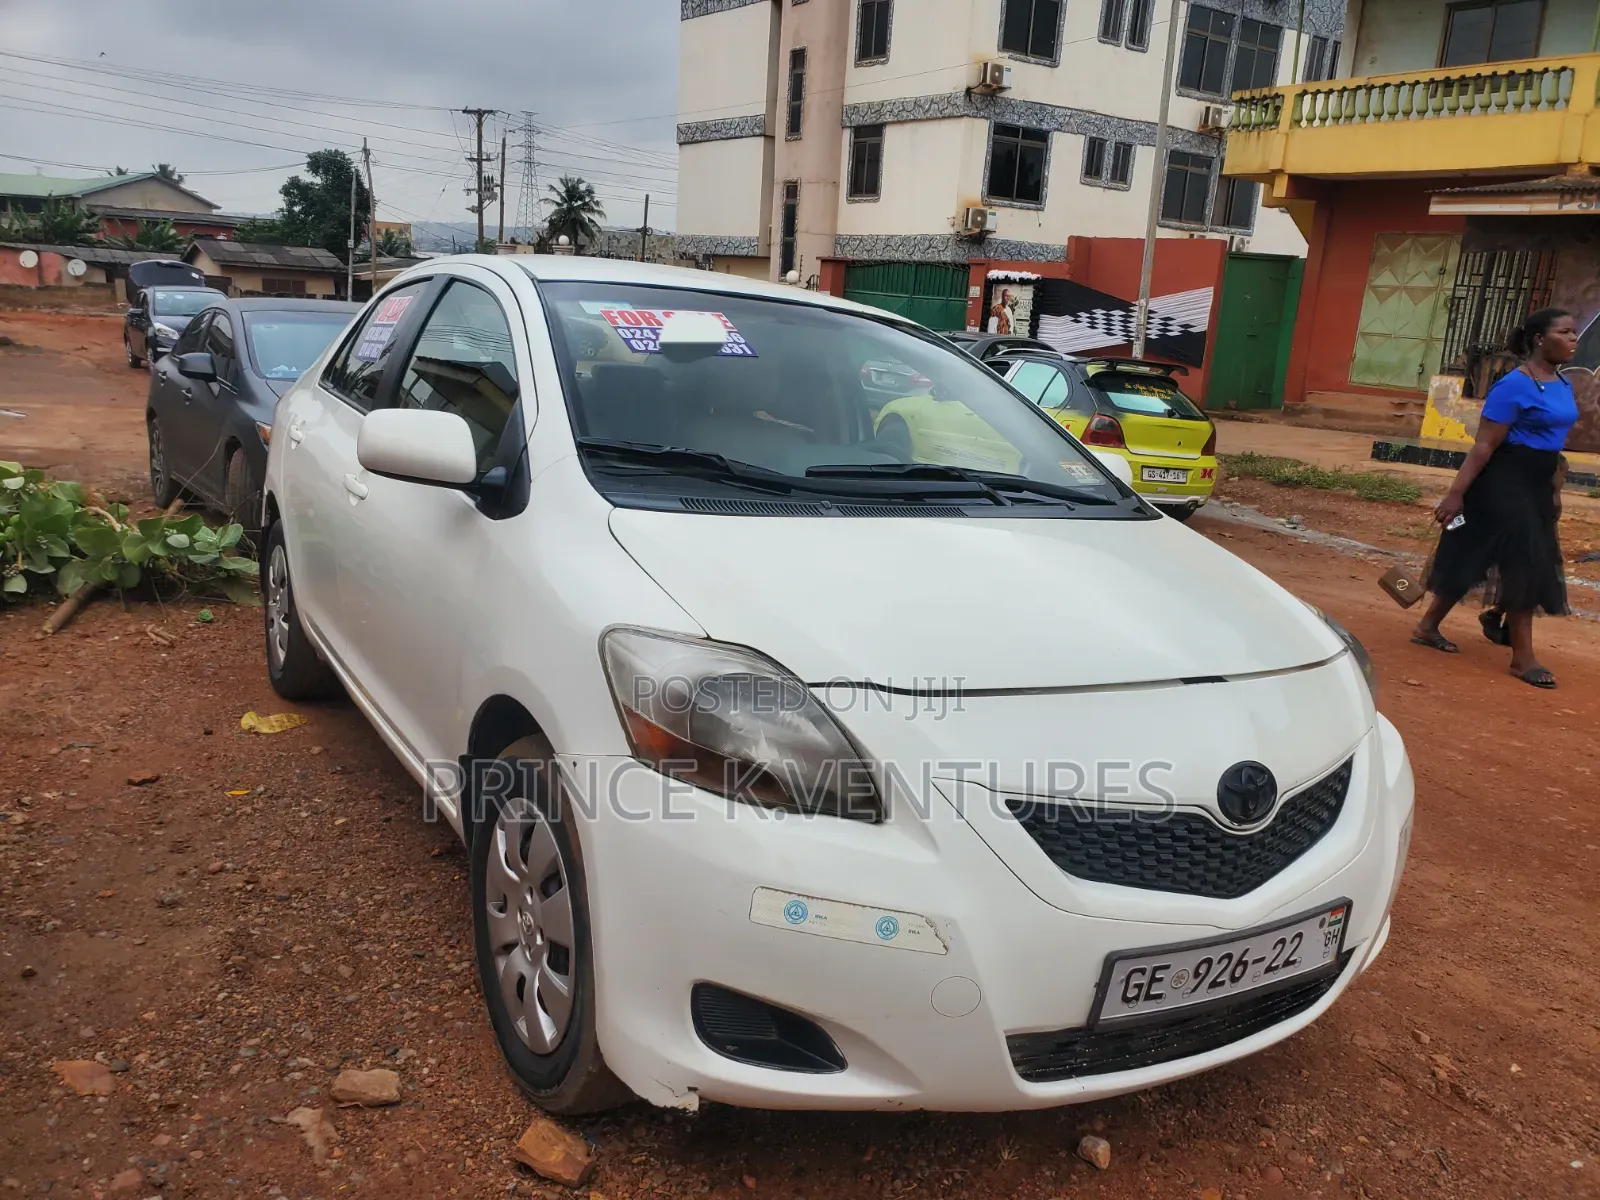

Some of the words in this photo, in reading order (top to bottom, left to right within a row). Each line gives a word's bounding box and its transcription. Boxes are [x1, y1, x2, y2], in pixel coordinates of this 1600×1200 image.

[601, 310, 663, 326] FOR
[631, 340, 660, 351] 02
[1324, 927, 1340, 948] GH
[1121, 963, 1171, 1003] GE
[1190, 931, 1304, 994] 926-22
